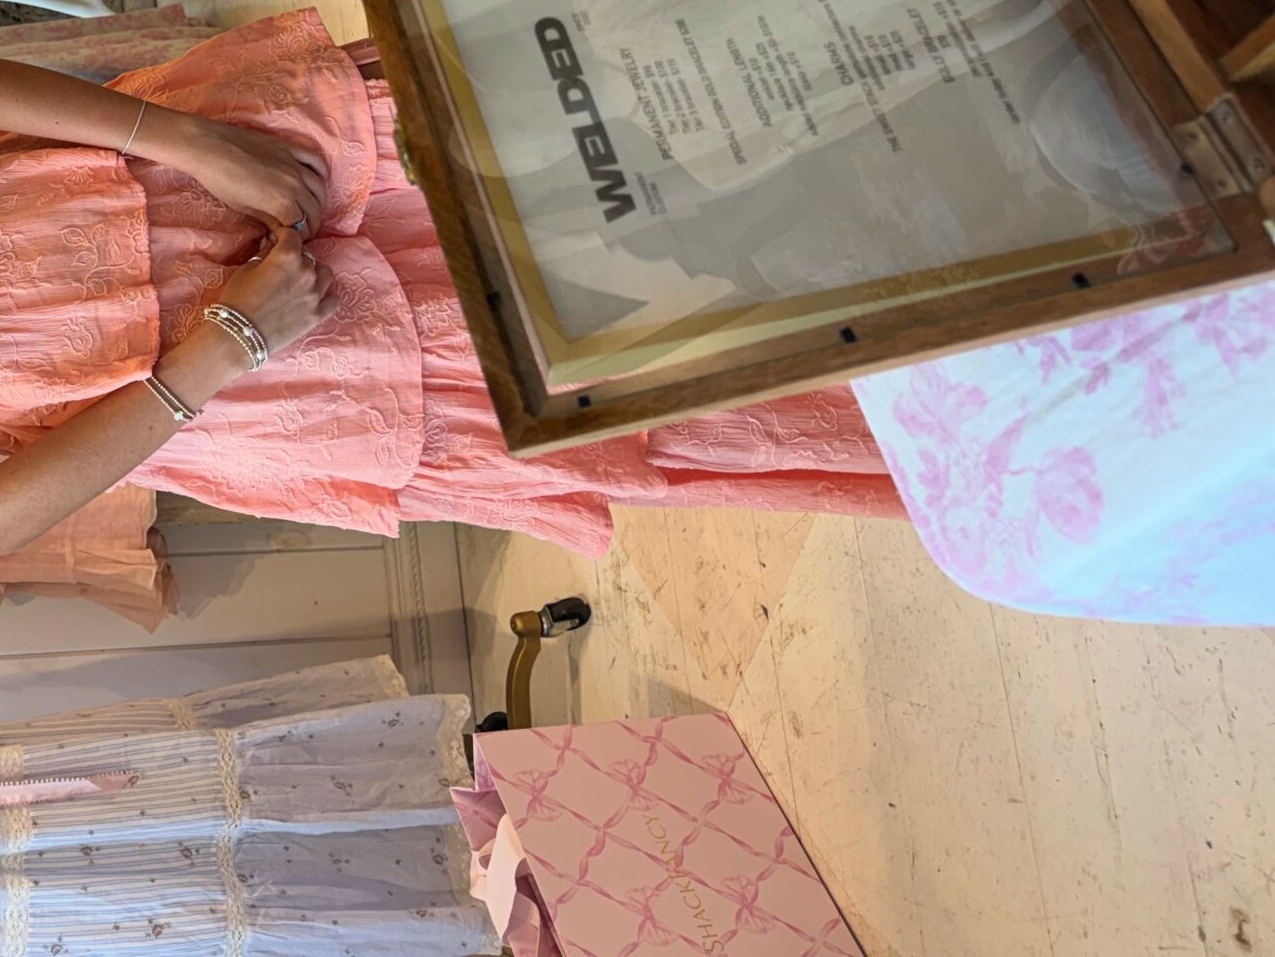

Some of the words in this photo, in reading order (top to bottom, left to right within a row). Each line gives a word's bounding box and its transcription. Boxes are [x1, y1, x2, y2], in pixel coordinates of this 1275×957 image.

[906, 9, 939, 54] BRACELET
[618, 49, 647, 92] JEWELRY
[682, 37, 706, 75] BRACELET
[726, 38, 748, 72] LENGTH
[823, 42, 853, 86] CHARMS
[700, 76, 716, 97] GOLD
[741, 72, 772, 128] ADDITIONAL
[860, 81, 879, 107] STACK
[533, 16, 636, 223] WELDED
[637, 96, 673, 161] PERMANENT
[712, 98, 730, 130] EDITION
[871, 109, 894, 136] SWEET
[726, 130, 746, 165] SPECIAL
[886, 136, 901, 154] THE
